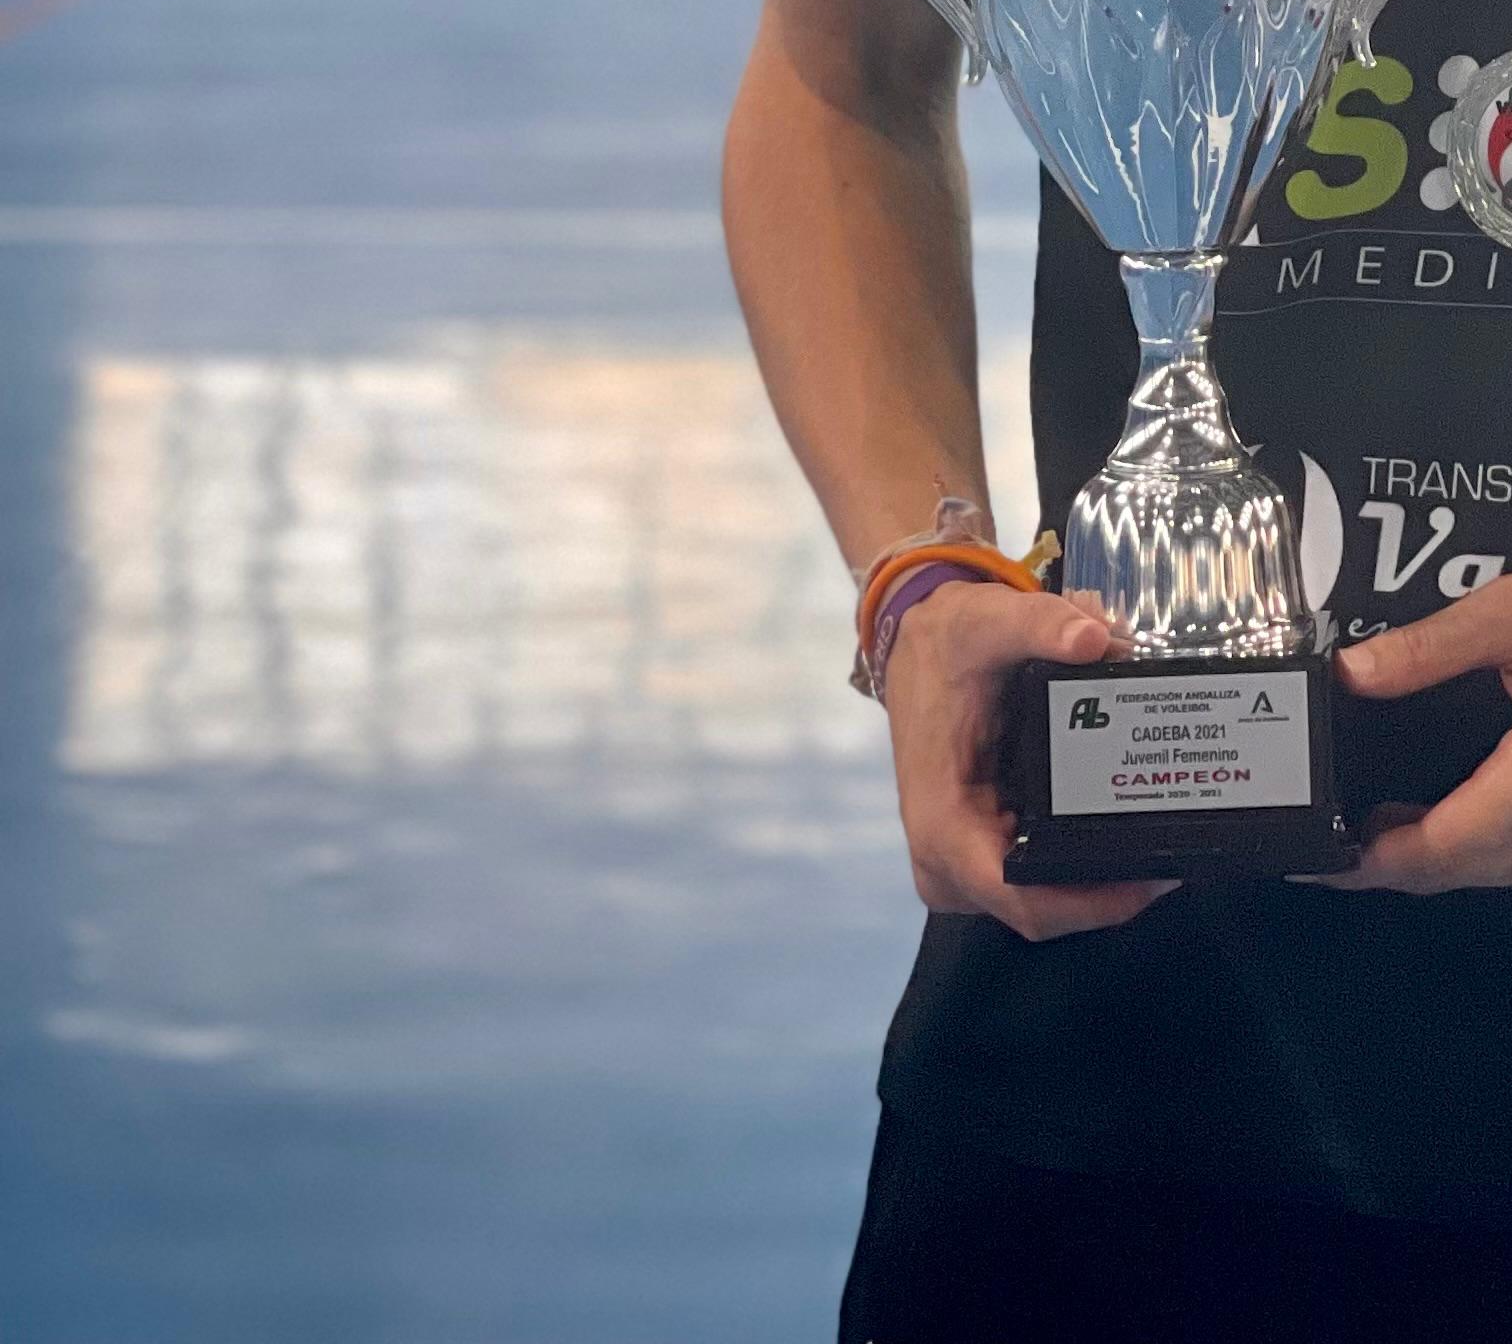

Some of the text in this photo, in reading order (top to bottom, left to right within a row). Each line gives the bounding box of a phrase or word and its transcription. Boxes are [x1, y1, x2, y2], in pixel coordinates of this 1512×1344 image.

[1115, 691, 1183, 704] FEDERACIÓN
[1184, 689, 1242, 701] ANDALUZA
[1144, 703, 1160, 714] DE
[1161, 703, 1213, 714] VOLEIBOL
[1131, 723, 1227, 742] CADEBA 2021
[1121, 748, 1239, 766] Juvenil Femenino
[1110, 766, 1251, 786] CAMPEÓN
